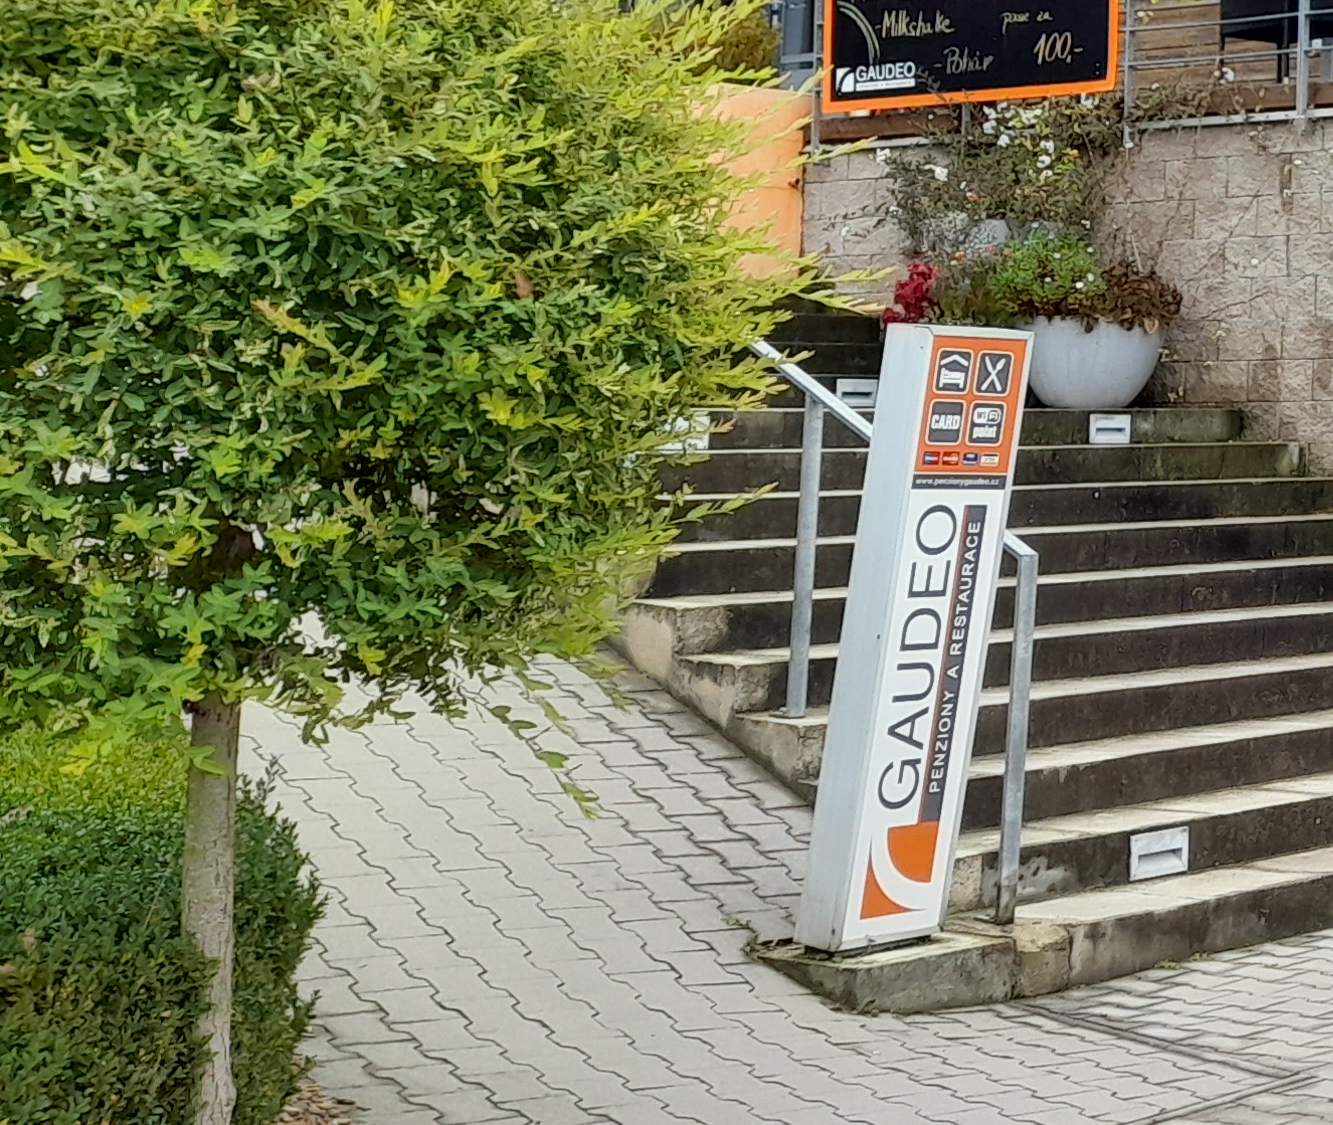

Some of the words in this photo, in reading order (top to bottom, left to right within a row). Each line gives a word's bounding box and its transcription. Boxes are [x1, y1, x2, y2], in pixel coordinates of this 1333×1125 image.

[855, 61, 916, 82] GAUDEO
[930, 414, 961, 430] CARD
[951, 520, 982, 656] RESTAURACE
[876, 503, 958, 811] GAUDEO
[946, 662, 960, 679] A
[928, 690, 955, 794] PENZIONY
